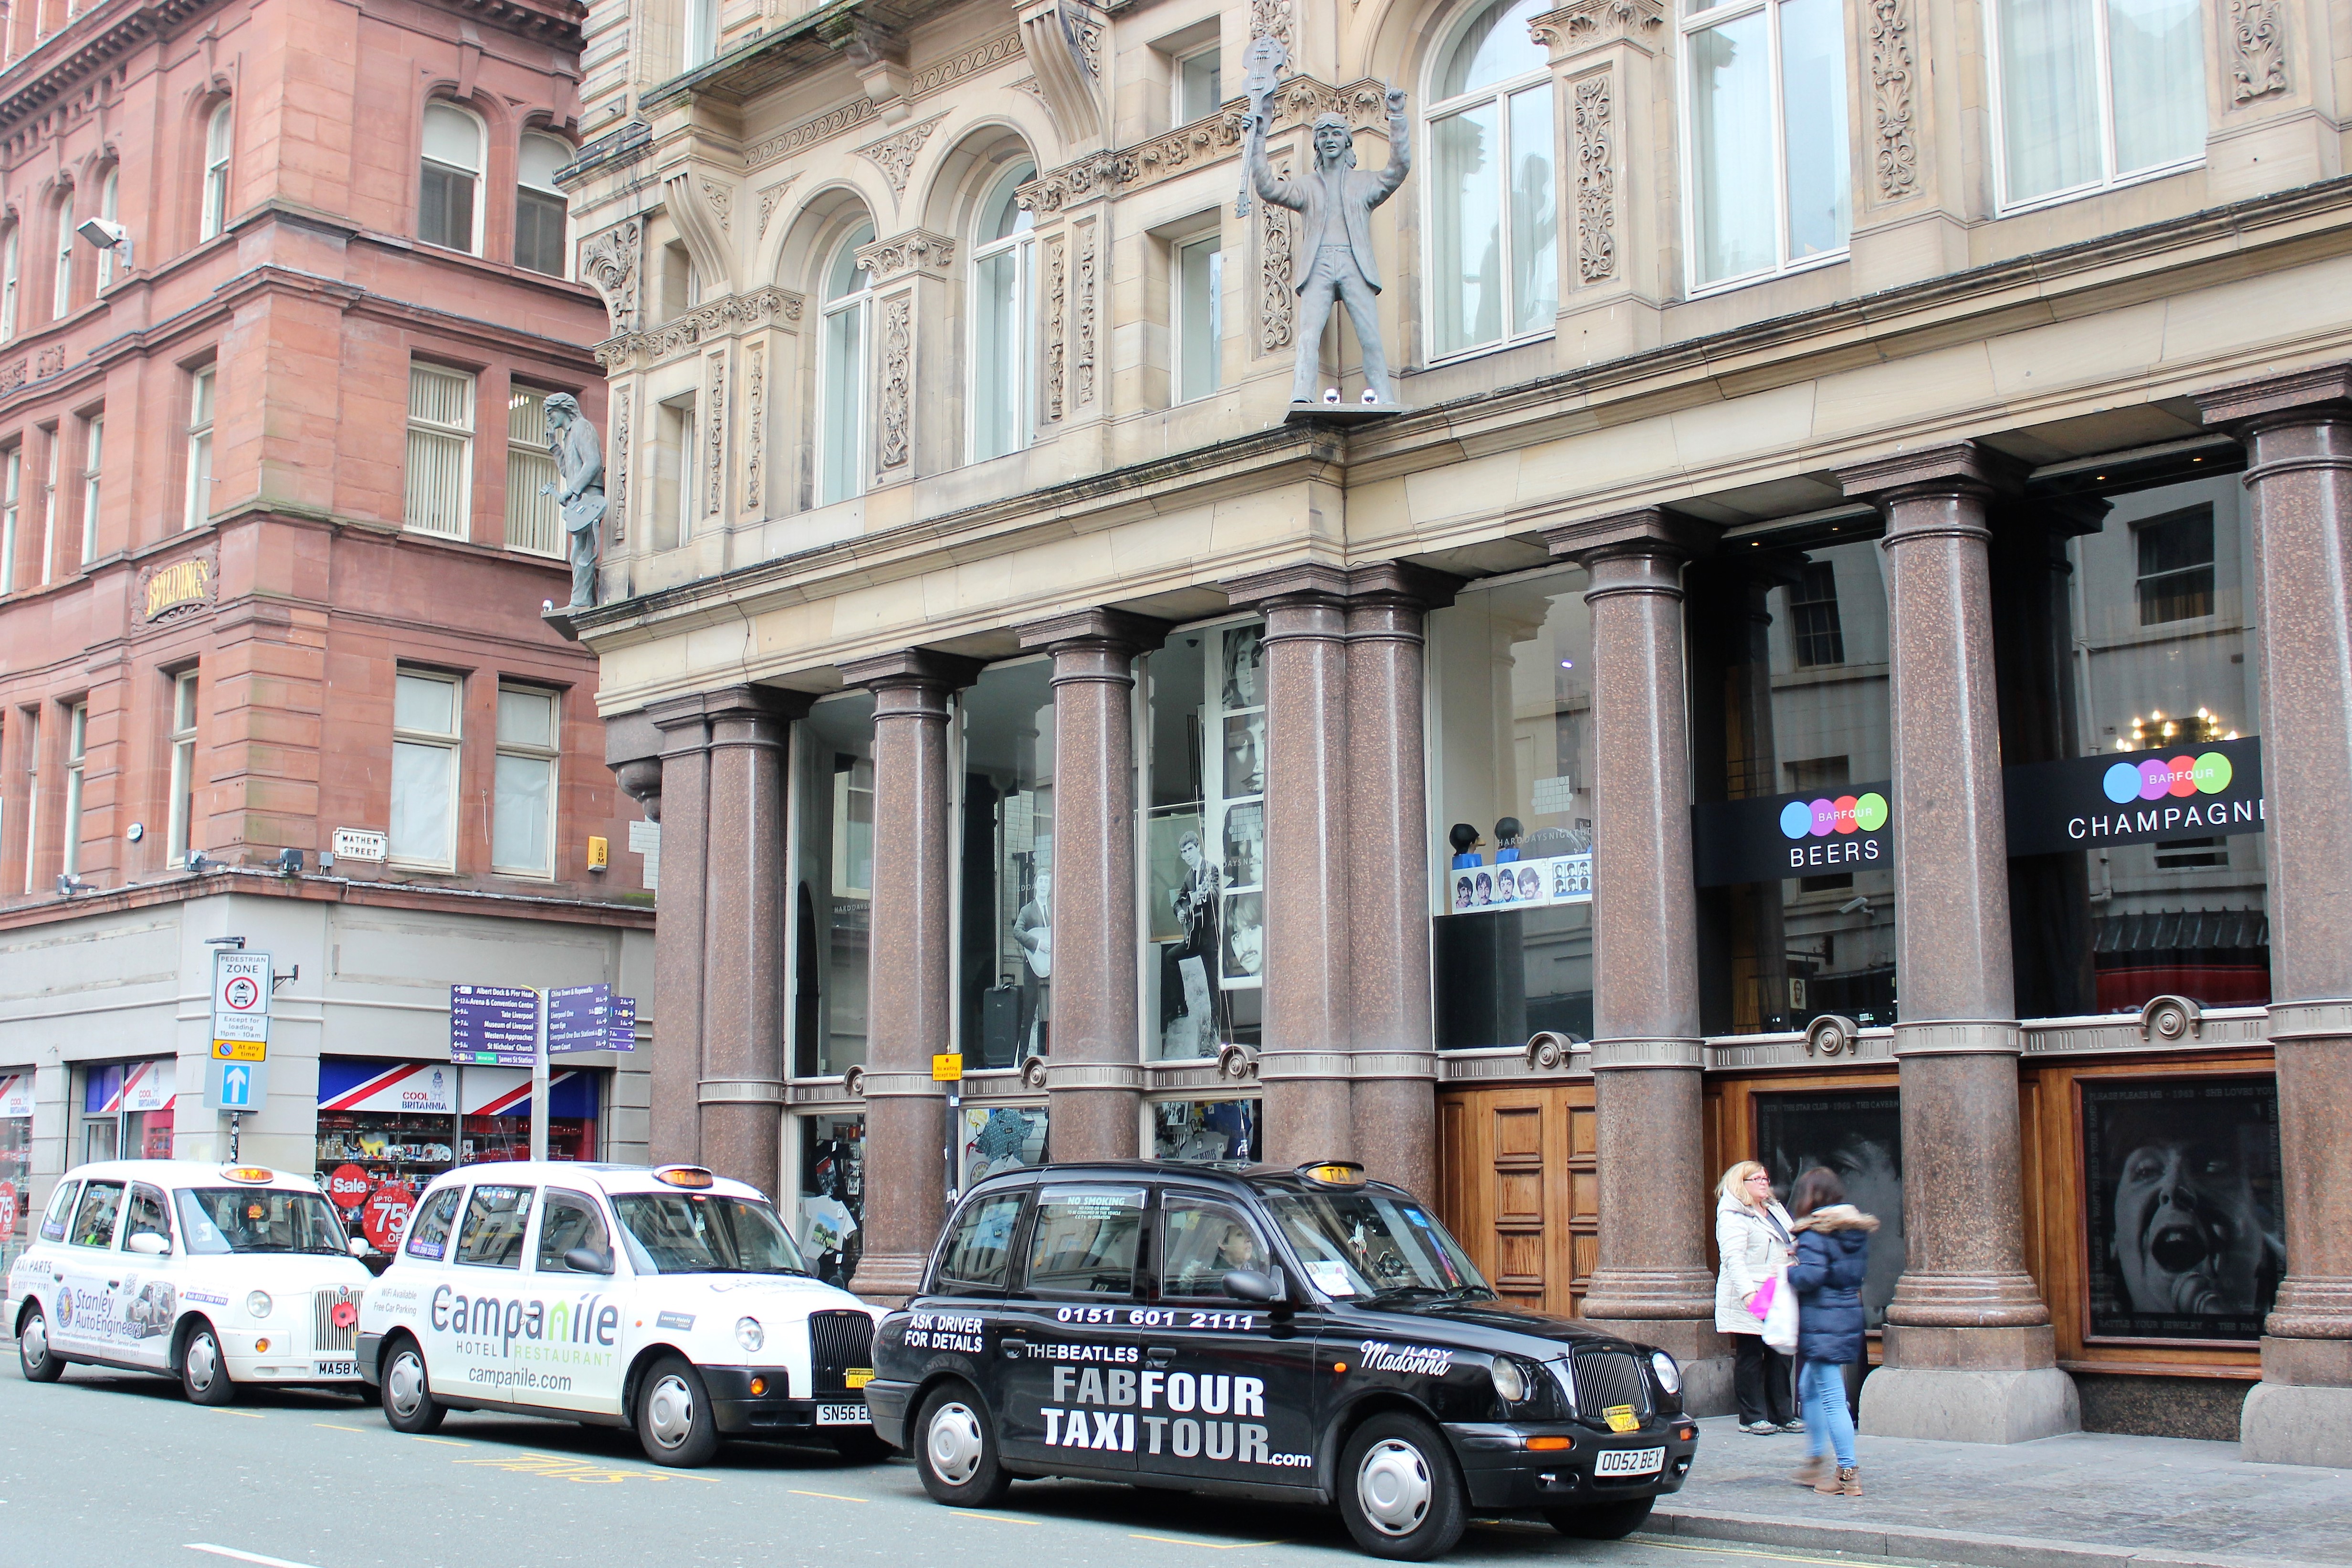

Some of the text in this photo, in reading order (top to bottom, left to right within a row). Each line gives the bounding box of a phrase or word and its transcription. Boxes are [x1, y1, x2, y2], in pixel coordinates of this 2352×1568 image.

[146, 559, 209, 617] BUILDINGS
[2149, 768, 2215, 785] BARFOUR
[1818, 807, 1872, 822] BARFOUR
[342, 834, 379, 846] MATHEW
[344, 845, 378, 856] STREET
[1789, 839, 1880, 868] BEERS
[227, 964, 259, 974] ZONE
[476, 987, 492, 995] Albert
[521, 990, 535, 998] Head
[551, 989, 561, 998] China
[470, 998, 485, 1006] Arena
[491, 999, 517, 1008] Convention
[518, 1000, 534, 1009] Centre
[224, 1016, 248, 1024] Except
[501, 1010, 534, 1021] Tate Liverpool
[229, 1023, 254, 1031] loading
[483, 1020, 505, 1029] Museum
[512, 1022, 534, 1031] Liverpool
[484, 1031, 534, 1042] Western Approaches
[516, 1043, 534, 1052] Church
[499, 1055, 512, 1063] James
[138, 1089, 152, 1098] COOL
[402, 1091, 429, 1102] COOL
[2225, 1087, 2254, 1097] LOVES
[138, 1098, 161, 1107] BRITANNIA
[402, 1100, 447, 1111] BRITANNIA
[237, 1170, 264, 1180] TAXI
[333, 1178, 367, 1194] Sale
[1067, 1196, 1125, 1206] NO SMOKING
[387, 1232, 403, 1243] OF
[29, 1260, 52, 1274] PARTS
[382, 1288, 417, 1300] WiFi Available
[75, 1288, 115, 1318] Stanley
[373, 1301, 417, 1317] Free Car Parking
[661, 1314, 691, 1324] Louvre Hotels
[909, 1314, 983, 1334] ASK DRIVER
[1057, 1306, 1254, 1331] 0151 601 2111
[904, 1332, 983, 1353] FOR DETAILS
[456, 1340, 612, 1368] HOTEL RESTAURANT
[1360, 1340, 1452, 1377] Madonna
[1407, 1346, 1453, 1360] LADY
[319, 1363, 351, 1375] MA58
[469, 1367, 572, 1391] campanile.com
[823, 1406, 855, 1421] SN56
[1639, 1449, 1661, 1469] BEX
